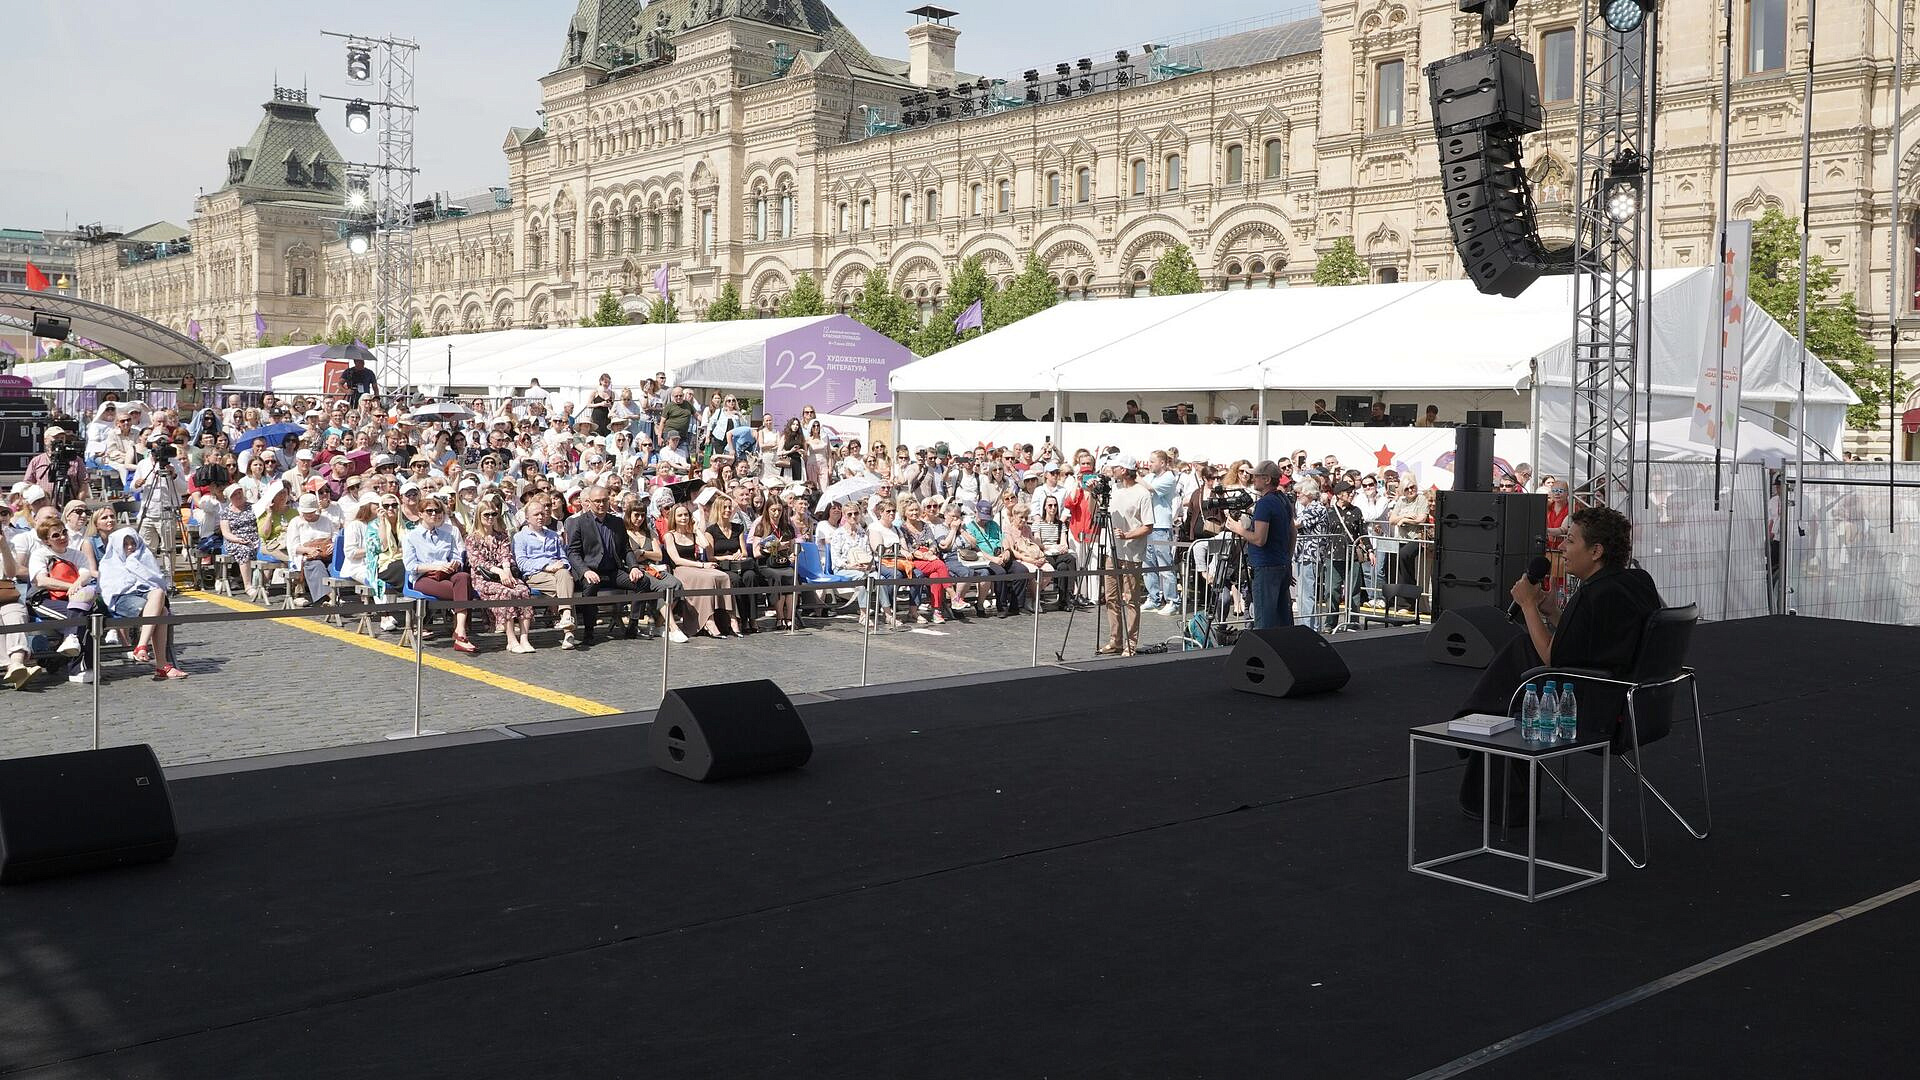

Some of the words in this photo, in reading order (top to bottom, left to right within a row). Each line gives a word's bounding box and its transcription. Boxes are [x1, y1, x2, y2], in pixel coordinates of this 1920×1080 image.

[826, 354, 886, 365] ХУДОЖЕСТВЕННАЯ
[770, 350, 825, 390] 23
[826, 363, 867, 373] ЛИТЕРАТУРА
